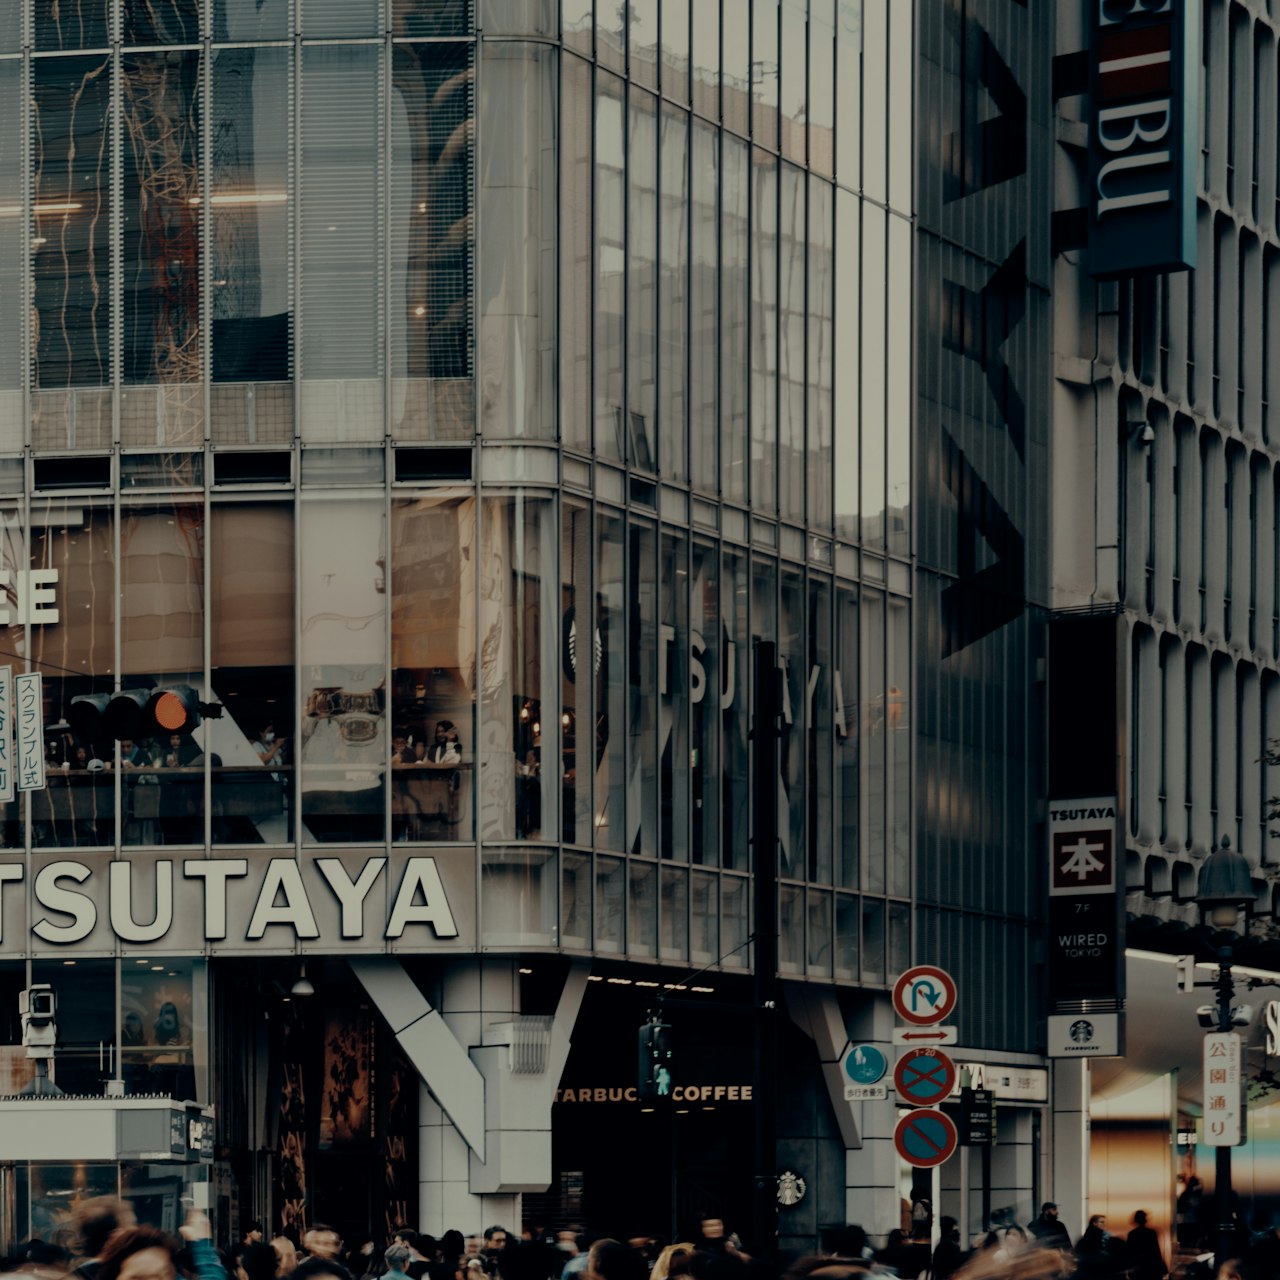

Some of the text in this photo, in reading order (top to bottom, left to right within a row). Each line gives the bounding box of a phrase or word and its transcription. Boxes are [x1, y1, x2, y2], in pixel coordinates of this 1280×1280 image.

[659, 622, 848, 739] TSUAYA
[21, 679, 38, 786] スクランブル式
[1050, 807, 1116, 821] TSUTAYA
[1059, 836, 1106, 881] 本
[1074, 903, 1091, 914] 7F
[1058, 932, 1108, 947] WIRED
[1065, 947, 1101, 958] TOKYO
[671, 1085, 753, 1101] COFFEE
[847, 1088, 885, 1098] 歩行者優先
[1209, 1042, 1227, 1136] 公園通り
